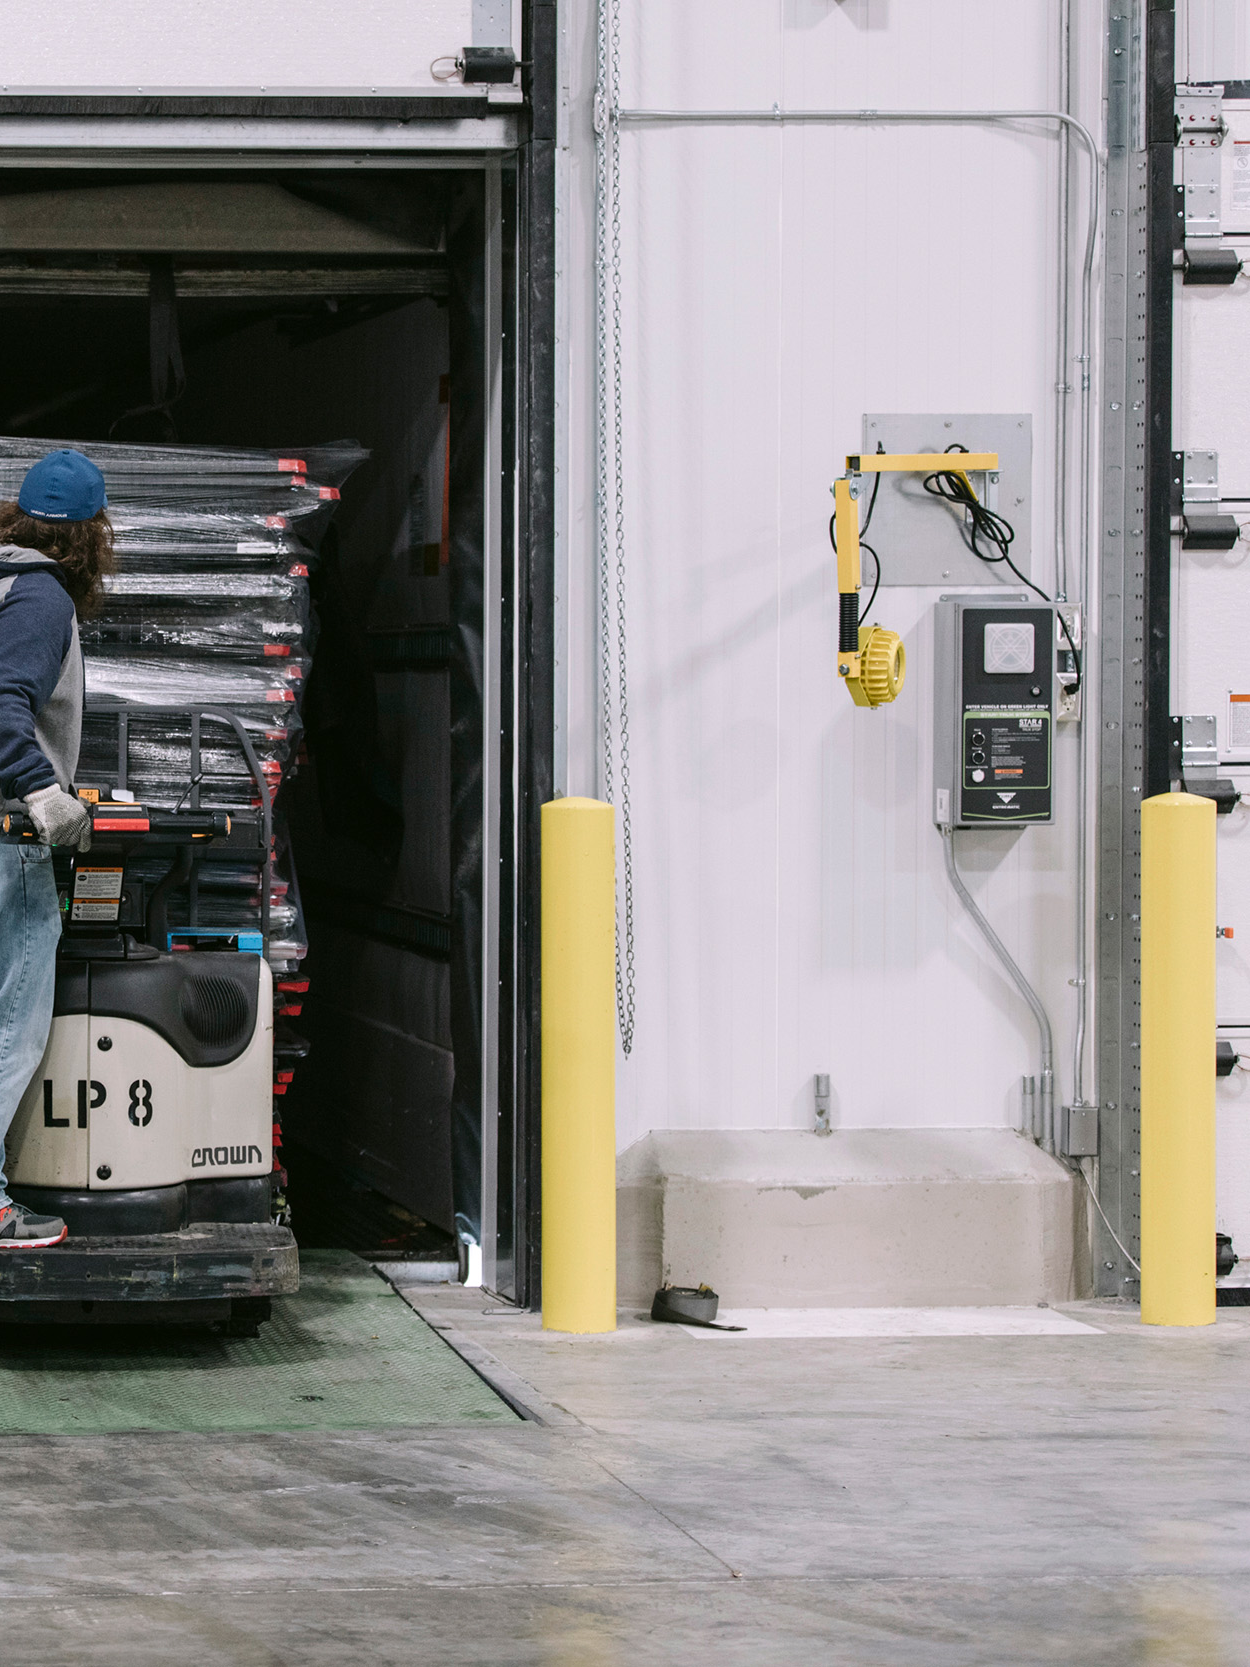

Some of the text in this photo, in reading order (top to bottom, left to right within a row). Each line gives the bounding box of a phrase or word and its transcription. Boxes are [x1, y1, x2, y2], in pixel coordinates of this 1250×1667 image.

[43, 1079, 153, 1128] LP 8
[192, 1145, 262, 1168] CROWN
